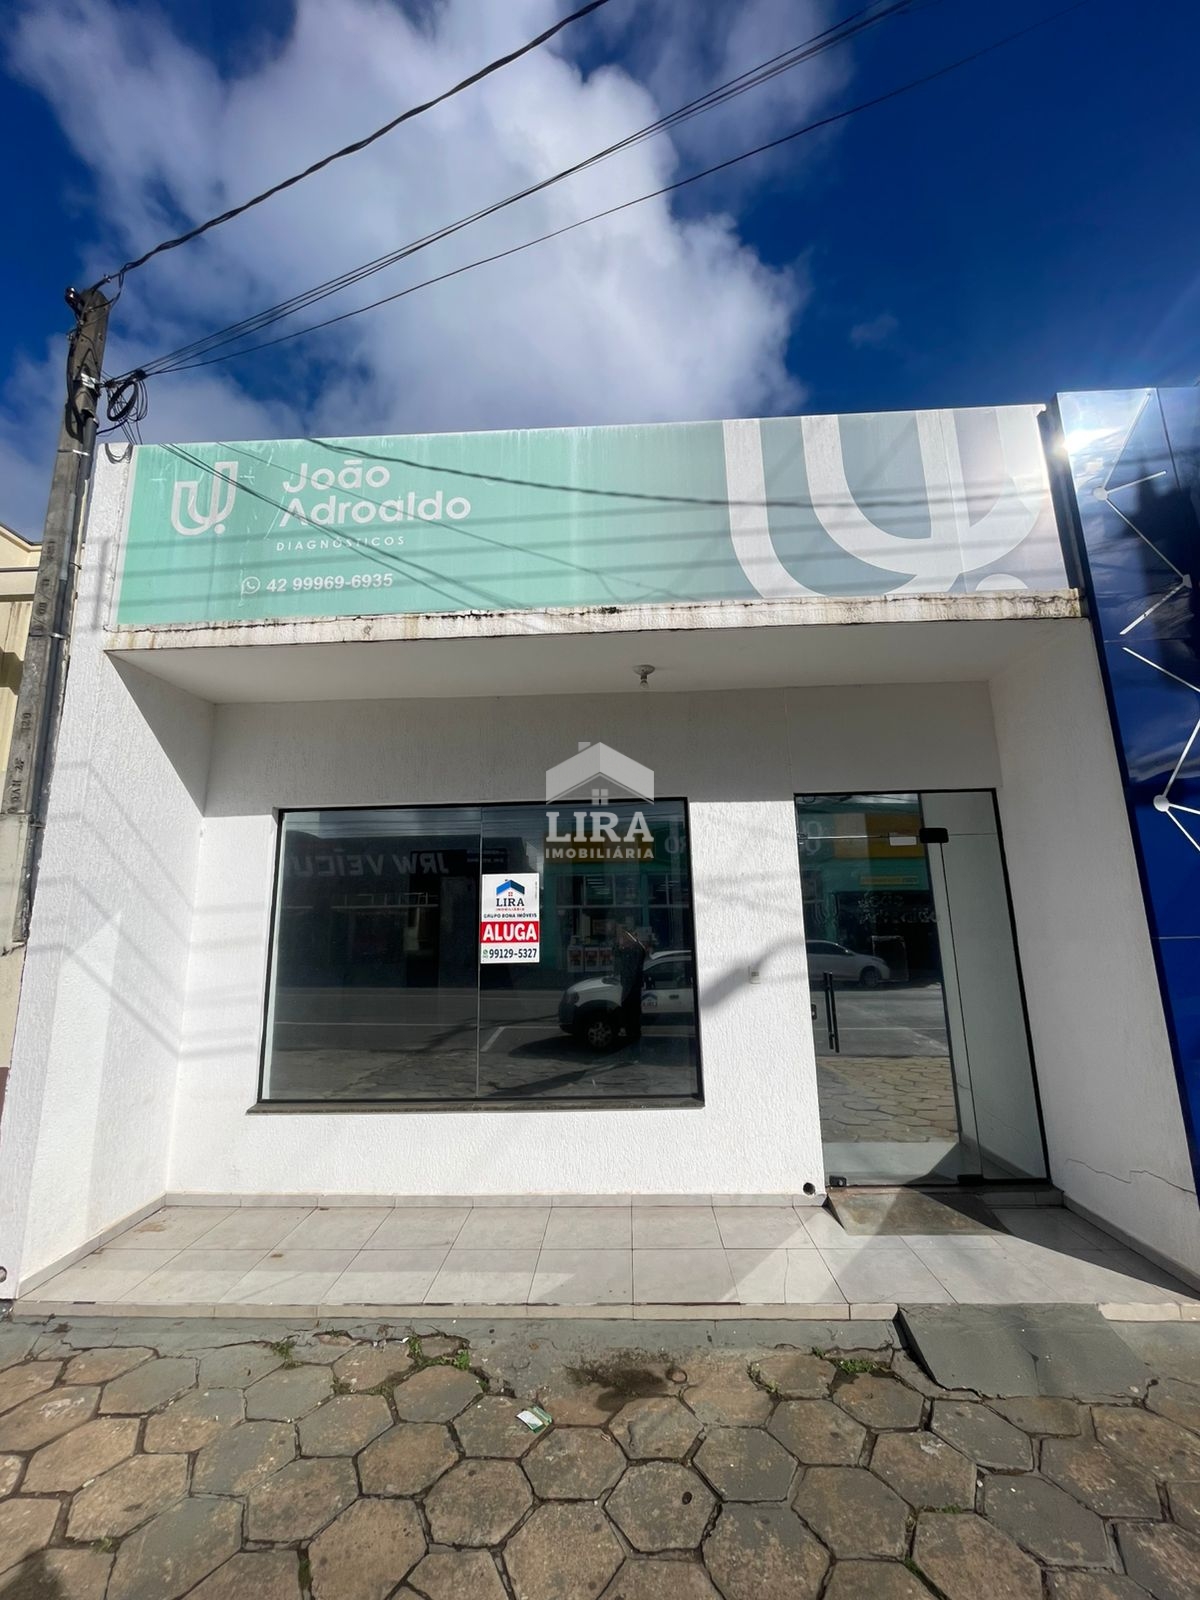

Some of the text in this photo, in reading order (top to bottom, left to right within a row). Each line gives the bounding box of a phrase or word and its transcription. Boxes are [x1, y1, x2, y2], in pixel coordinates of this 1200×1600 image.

[282, 460, 391, 494] João
[279, 490, 472, 529] Adroaldo
[276, 535, 405, 551] DIAGNÓSTICOS
[266, 573, 394, 593] 42 99969-6935
[495, 898, 525, 907] LIRA
[482, 923, 538, 942] ALUGA
[489, 948, 538, 959] 99129-5327
